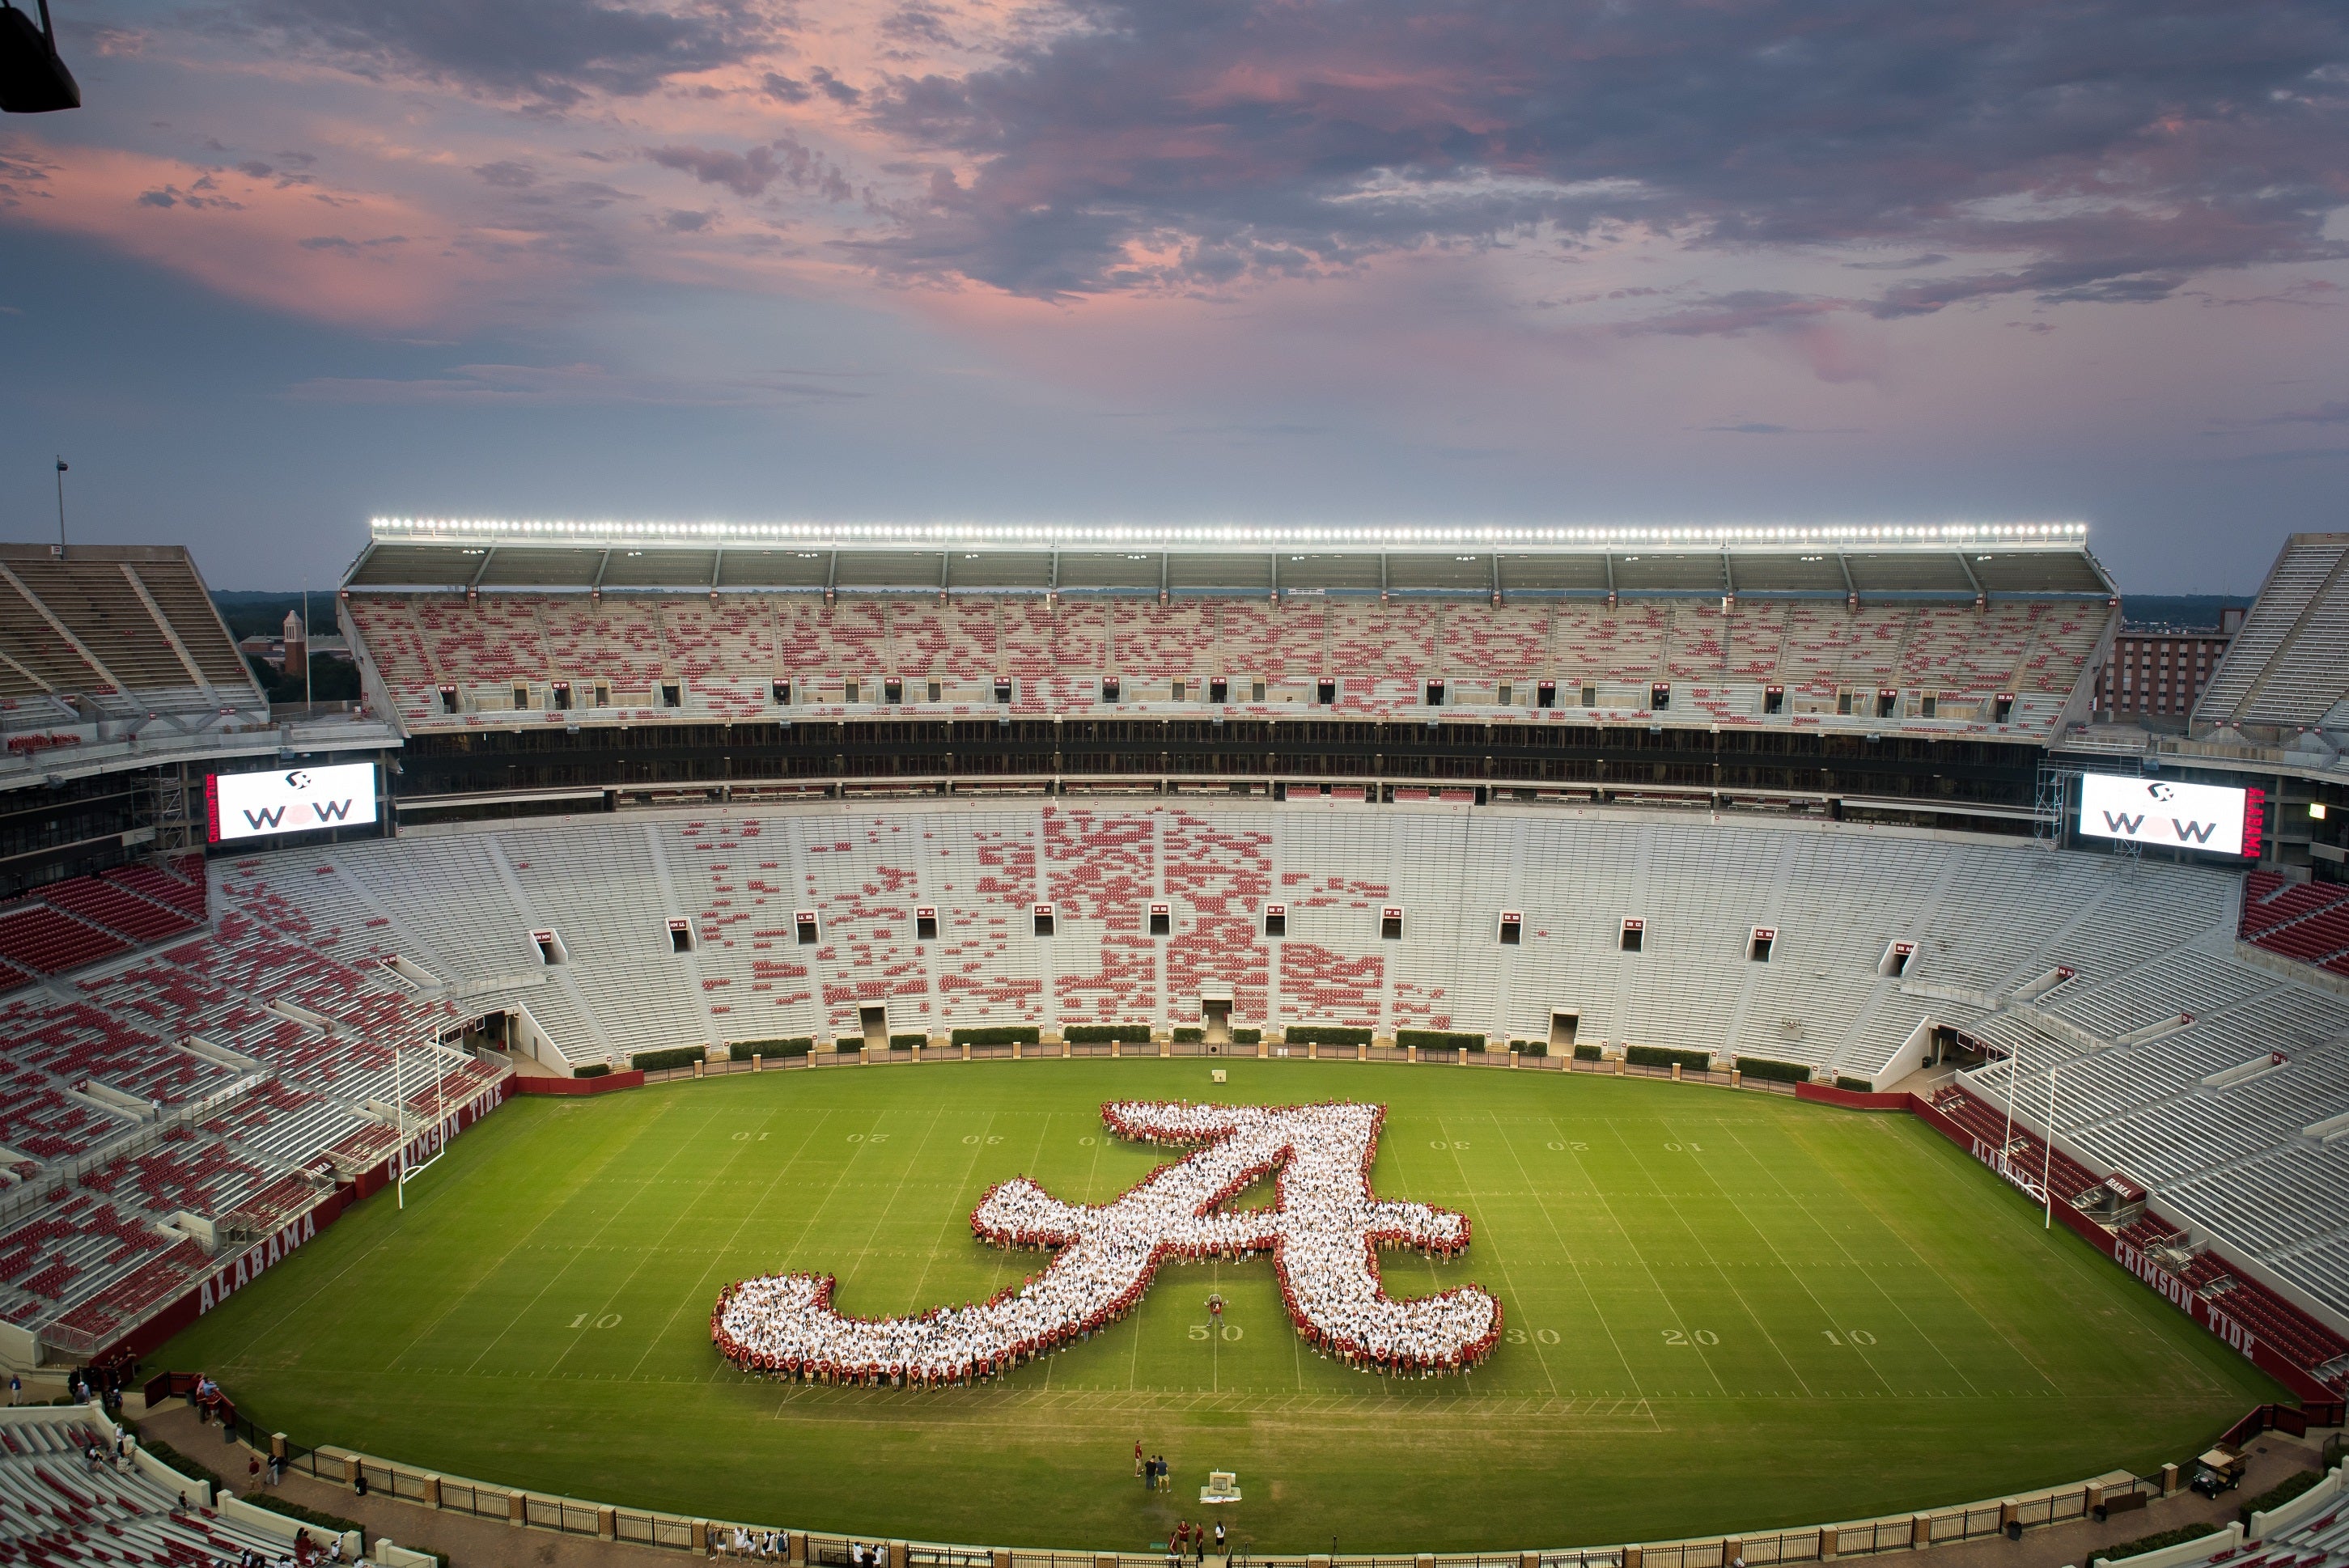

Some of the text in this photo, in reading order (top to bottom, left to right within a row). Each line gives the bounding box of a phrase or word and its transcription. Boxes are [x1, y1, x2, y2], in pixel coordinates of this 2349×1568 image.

[2243, 786, 2265, 858] ALABAMA
[388, 1083, 502, 1180] CRIMSON TIDE
[731, 1132, 771, 1141] 10
[846, 1134, 890, 1143] 20
[961, 1135, 1004, 1144] 30
[1429, 1141, 1470, 1151] 30
[1546, 1142, 1589, 1151] 20
[1663, 1142, 1705, 1152] 10
[1972, 1138, 2034, 1199] ALABAMA
[2105, 1177, 2131, 1197] BAMA
[710, 1097, 1503, 1389] A
[199, 1211, 316, 1316] ALABAMA
[2114, 1240, 2254, 1360] CRIMSON TIDE
[565, 1312, 622, 1328] 10
[1188, 1324, 1244, 1341] 50
[1506, 1329, 1561, 1345] 30
[1660, 1329, 1720, 1346] 20
[1821, 1330, 1877, 1345] 10
